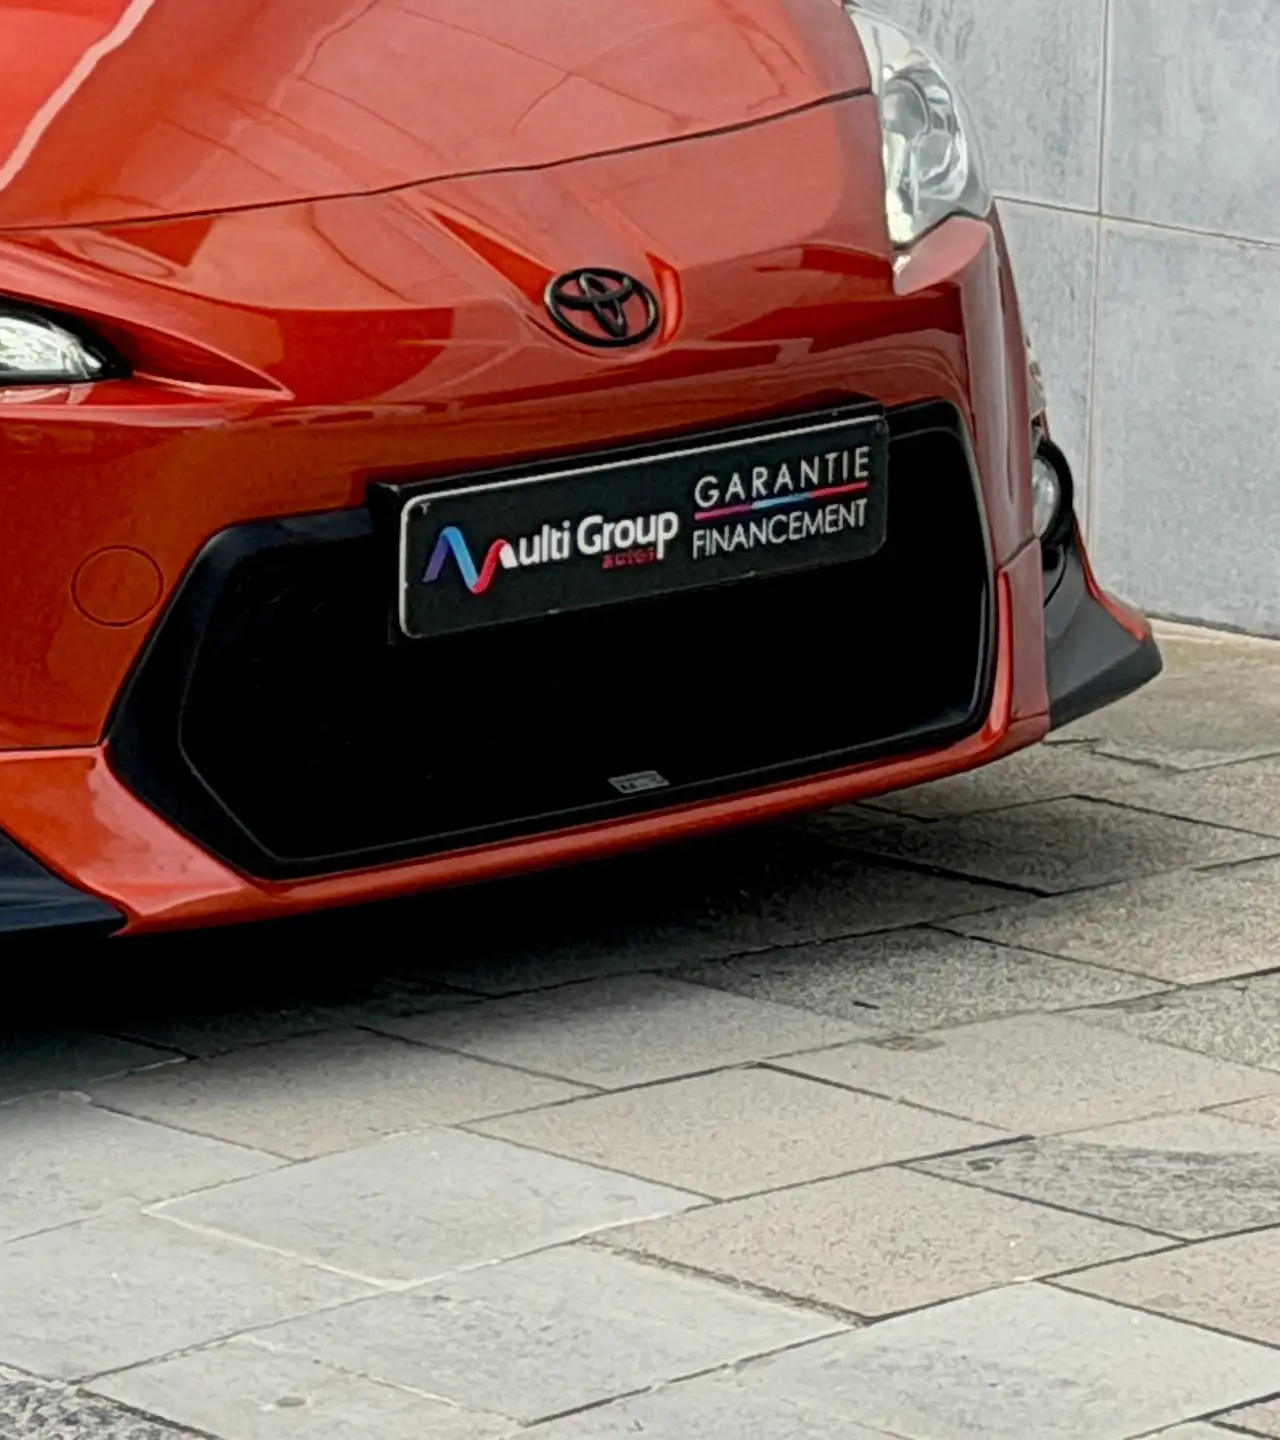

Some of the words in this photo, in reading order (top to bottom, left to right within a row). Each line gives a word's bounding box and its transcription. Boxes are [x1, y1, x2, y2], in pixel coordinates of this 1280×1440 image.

[694, 445, 871, 509] GARANTIE
[577, 511, 679, 561] Group
[692, 497, 869, 561] FINANCEMENT
